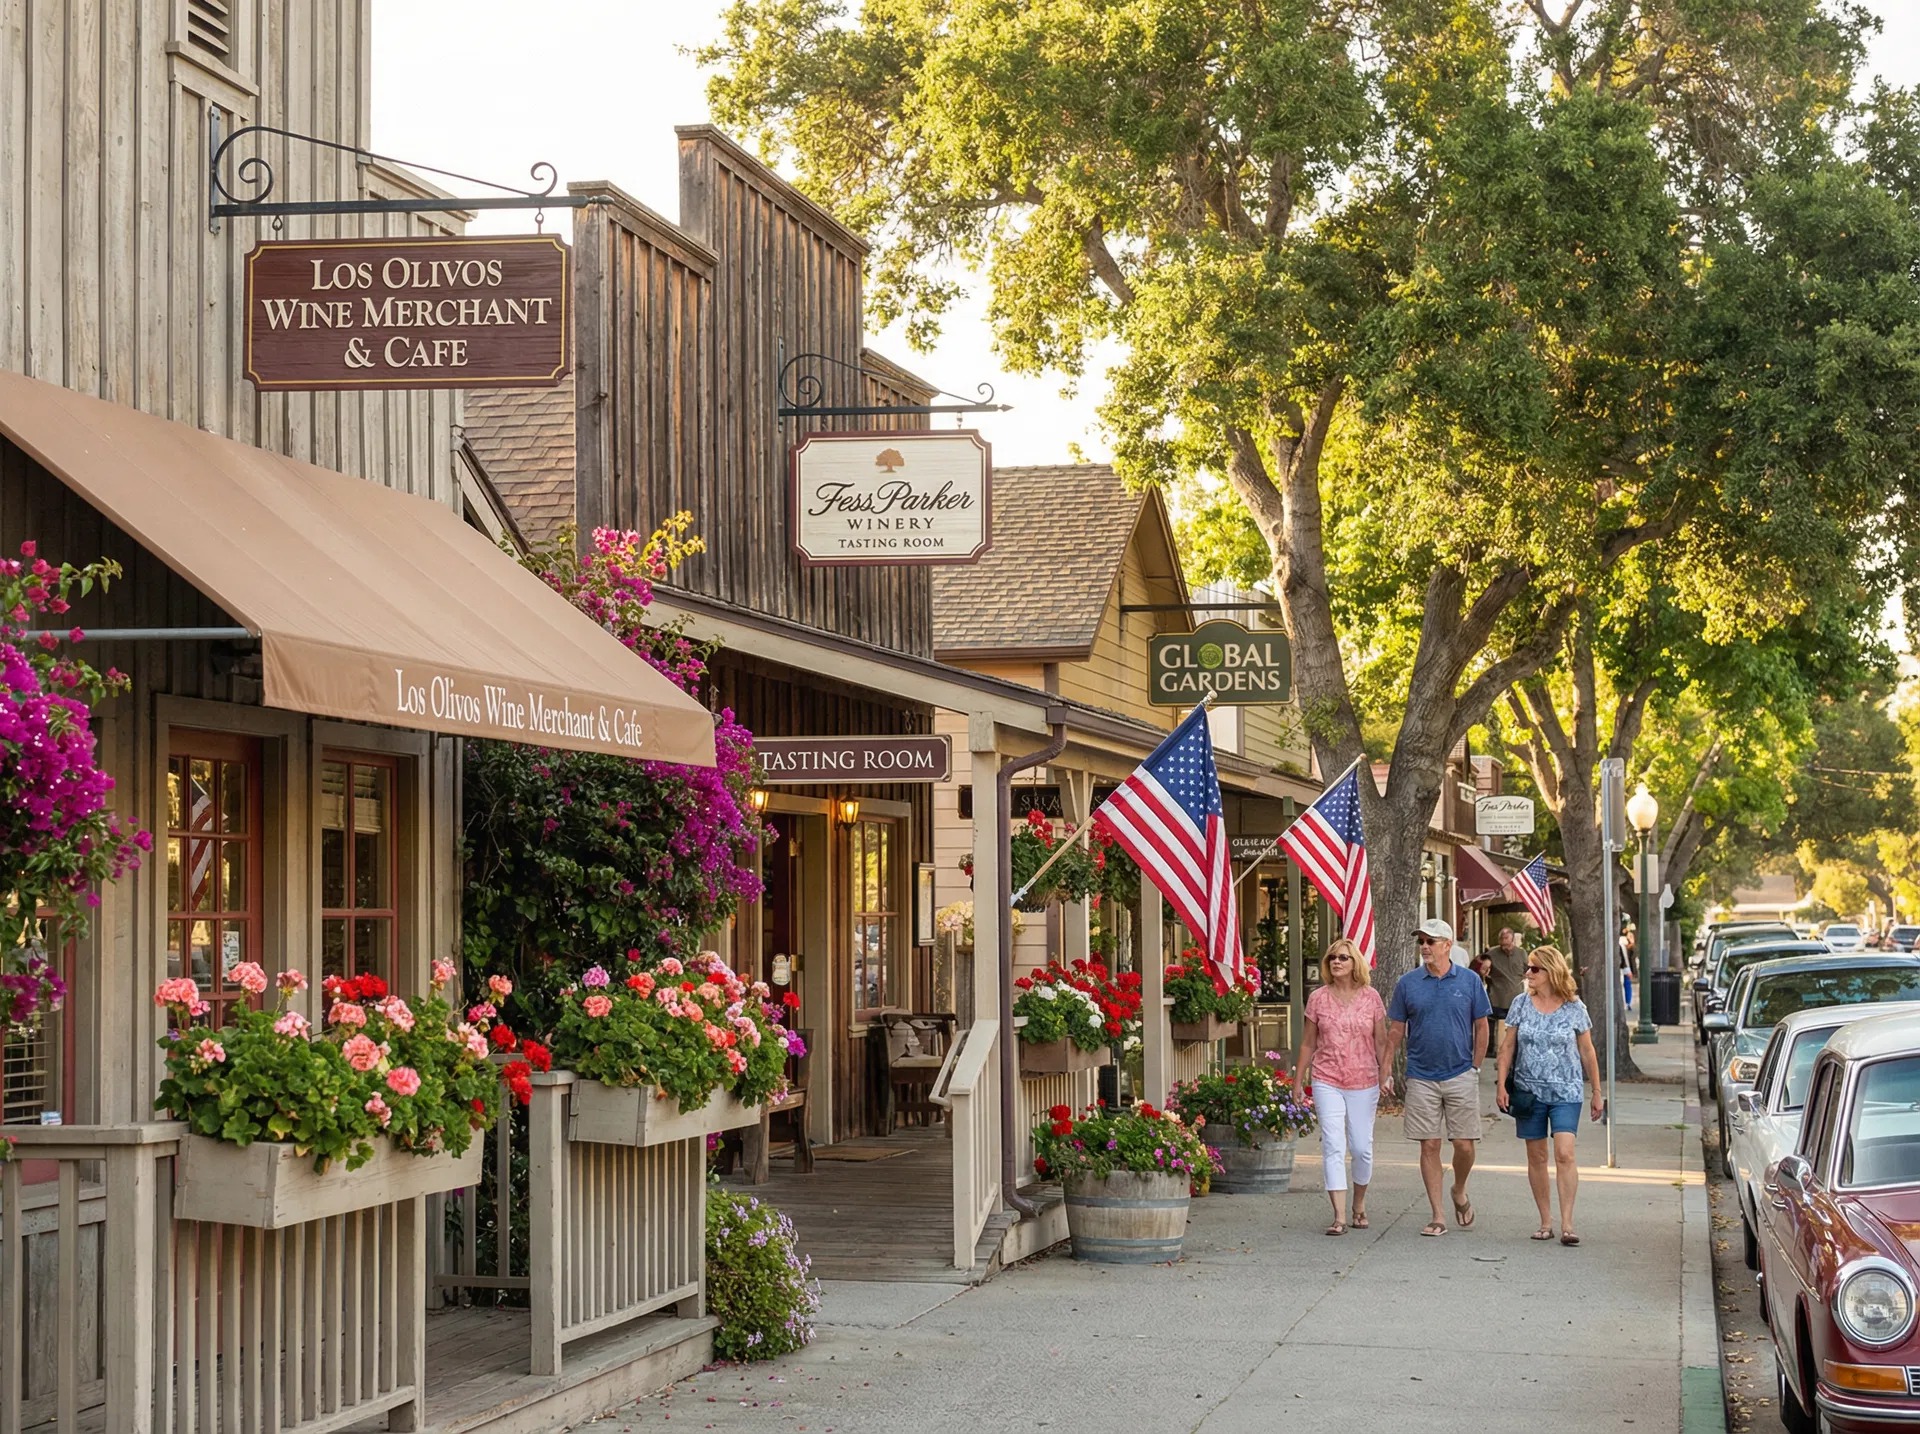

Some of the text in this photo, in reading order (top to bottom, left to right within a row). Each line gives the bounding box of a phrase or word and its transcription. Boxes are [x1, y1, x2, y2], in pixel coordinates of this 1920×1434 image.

[310, 257, 503, 291] LOS OLIVOS
[261, 296, 552, 330] WINE MERCHANT
[344, 336, 468, 368] & CAFE
[808, 480, 975, 516] Fess Parker
[847, 517, 935, 530] WINERY
[838, 537, 944, 549] TASTING ROOM
[1159, 643, 1280, 669] GLOBAL
[1159, 670, 1281, 692] GARDENS
[395, 669, 643, 747] Los Olivos Wine Merchant & Cafe
[758, 750, 935, 771] TASTING ROOM
